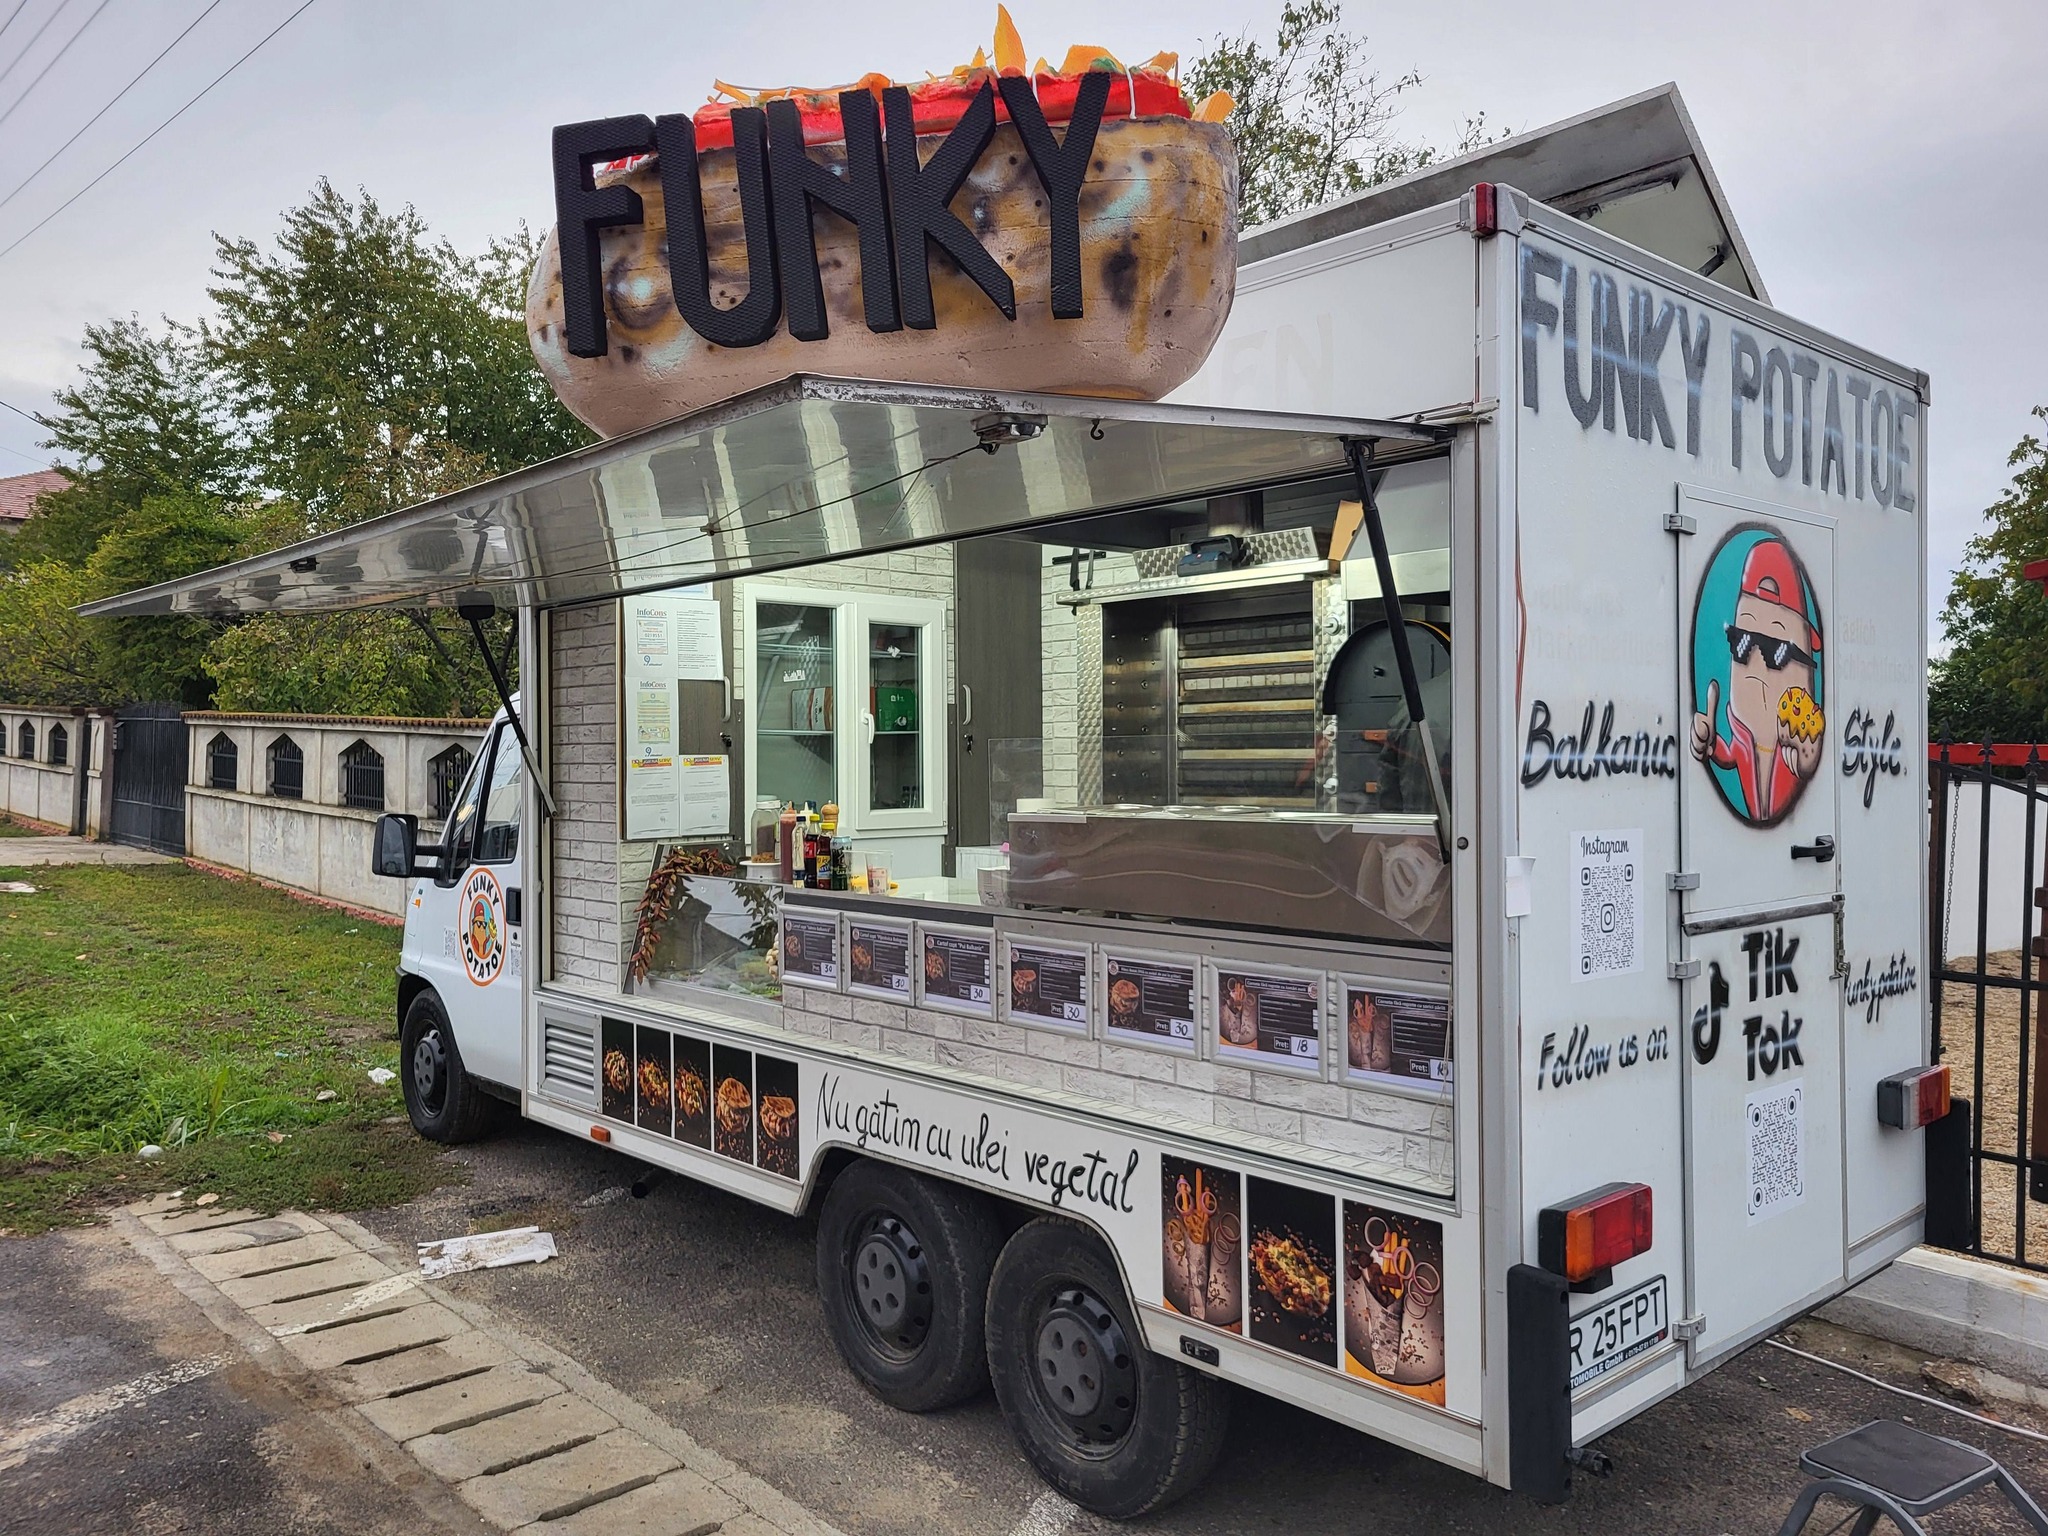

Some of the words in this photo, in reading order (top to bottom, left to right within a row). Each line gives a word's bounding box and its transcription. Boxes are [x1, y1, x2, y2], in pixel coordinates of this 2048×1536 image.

[552, 71, 1111, 358] FUNKY
[1521, 242, 1711, 458] FUNKY
[1730, 328, 1918, 514] POTATOE
[636, 608, 667, 617] InfoCons
[1520, 699, 1676, 789] Balkanic
[1580, 835, 1630, 863] Instagram
[466, 874, 500, 907] FUNKY
[462, 931, 503, 979] POTATOE
[824, 965, 833, 973] 30
[1741, 927, 1800, 1003] Tik
[973, 988, 984, 998] 30
[1066, 1005, 1080, 1019] 30
[1174, 1021, 1188, 1036] 30
[1296, 1039, 1309, 1053] 18
[1537, 1022, 1612, 1091] Follow
[1618, 1034, 1639, 1068] us
[1646, 1025, 1670, 1062] on
[1742, 1010, 1805, 1082] Tok
[815, 1070, 850, 1142] Nu
[926, 1124, 953, 1161] cu
[960, 1112, 1010, 1182] ulei
[1024, 1147, 1139, 1214] vegetal
[1604, 1352, 1624, 1370] GmbH
